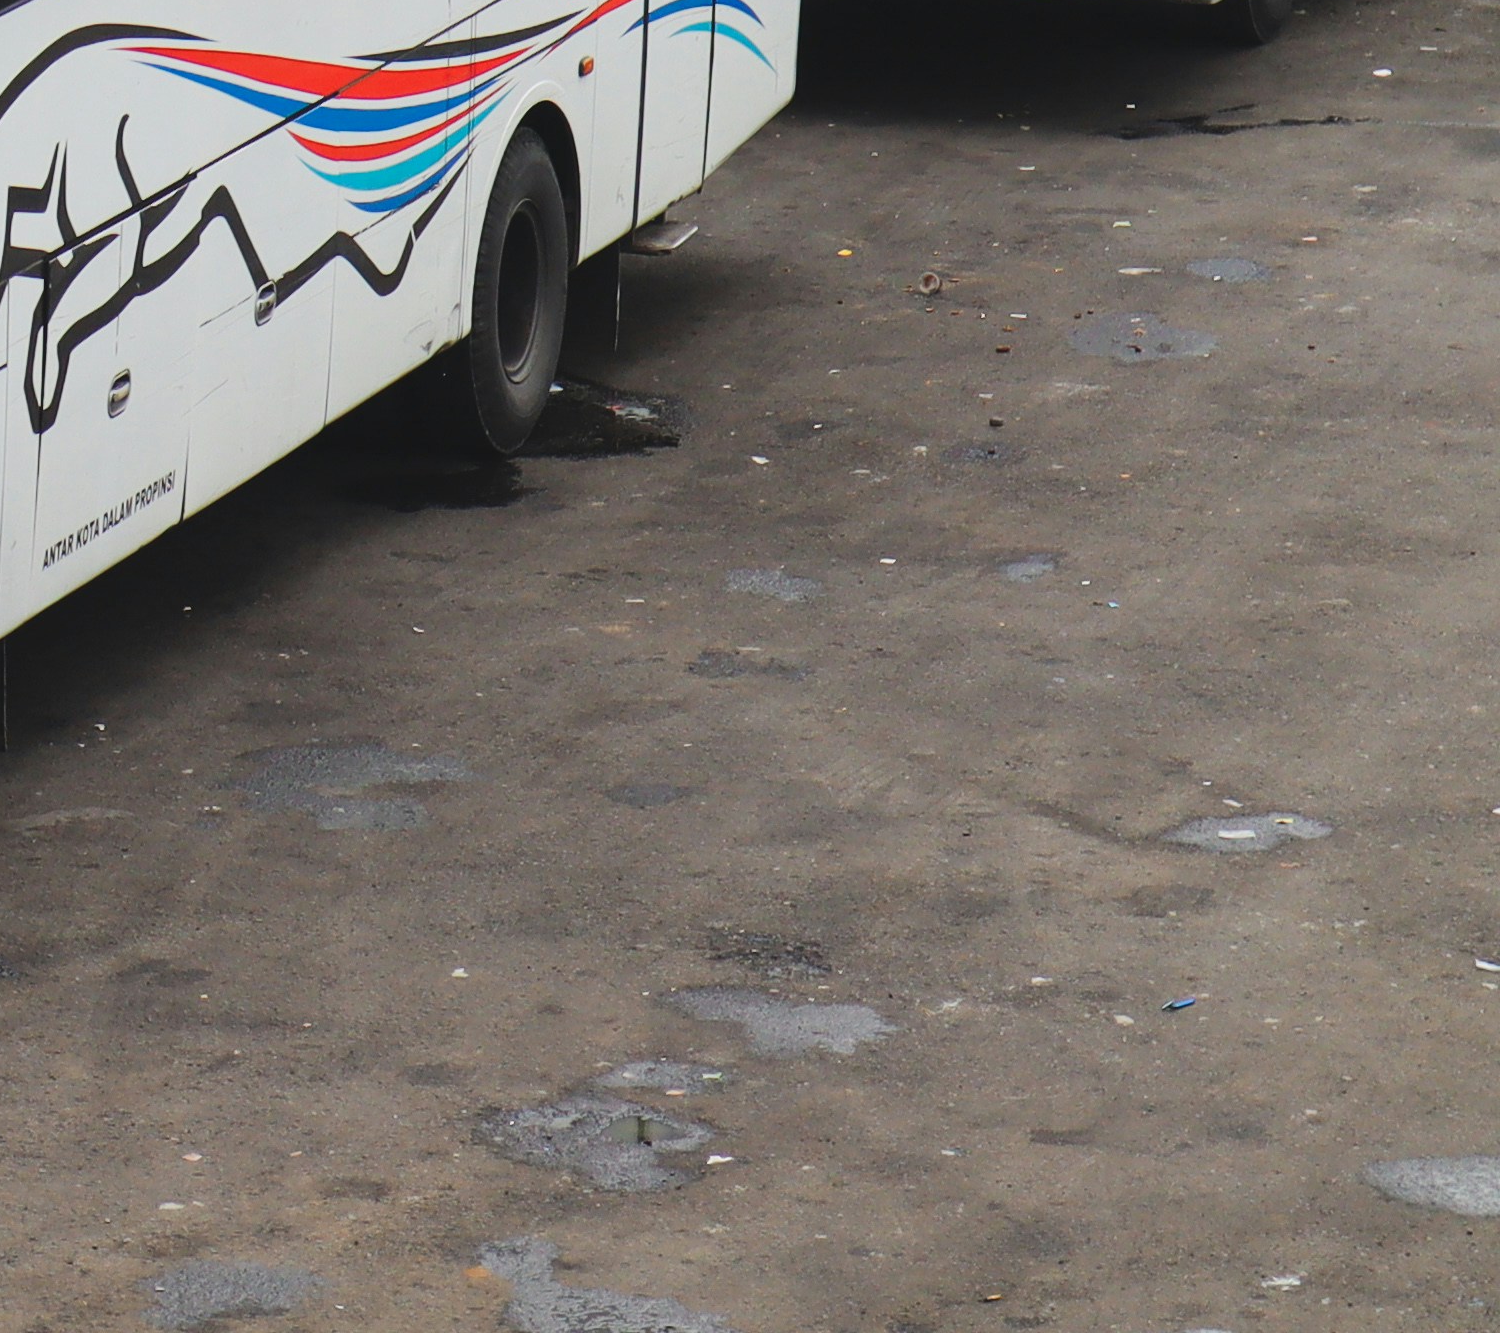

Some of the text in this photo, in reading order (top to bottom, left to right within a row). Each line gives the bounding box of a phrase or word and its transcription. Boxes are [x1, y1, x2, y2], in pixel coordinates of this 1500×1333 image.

[43, 469, 176, 571] ANTAR KOTA DALAM PROPINSI
